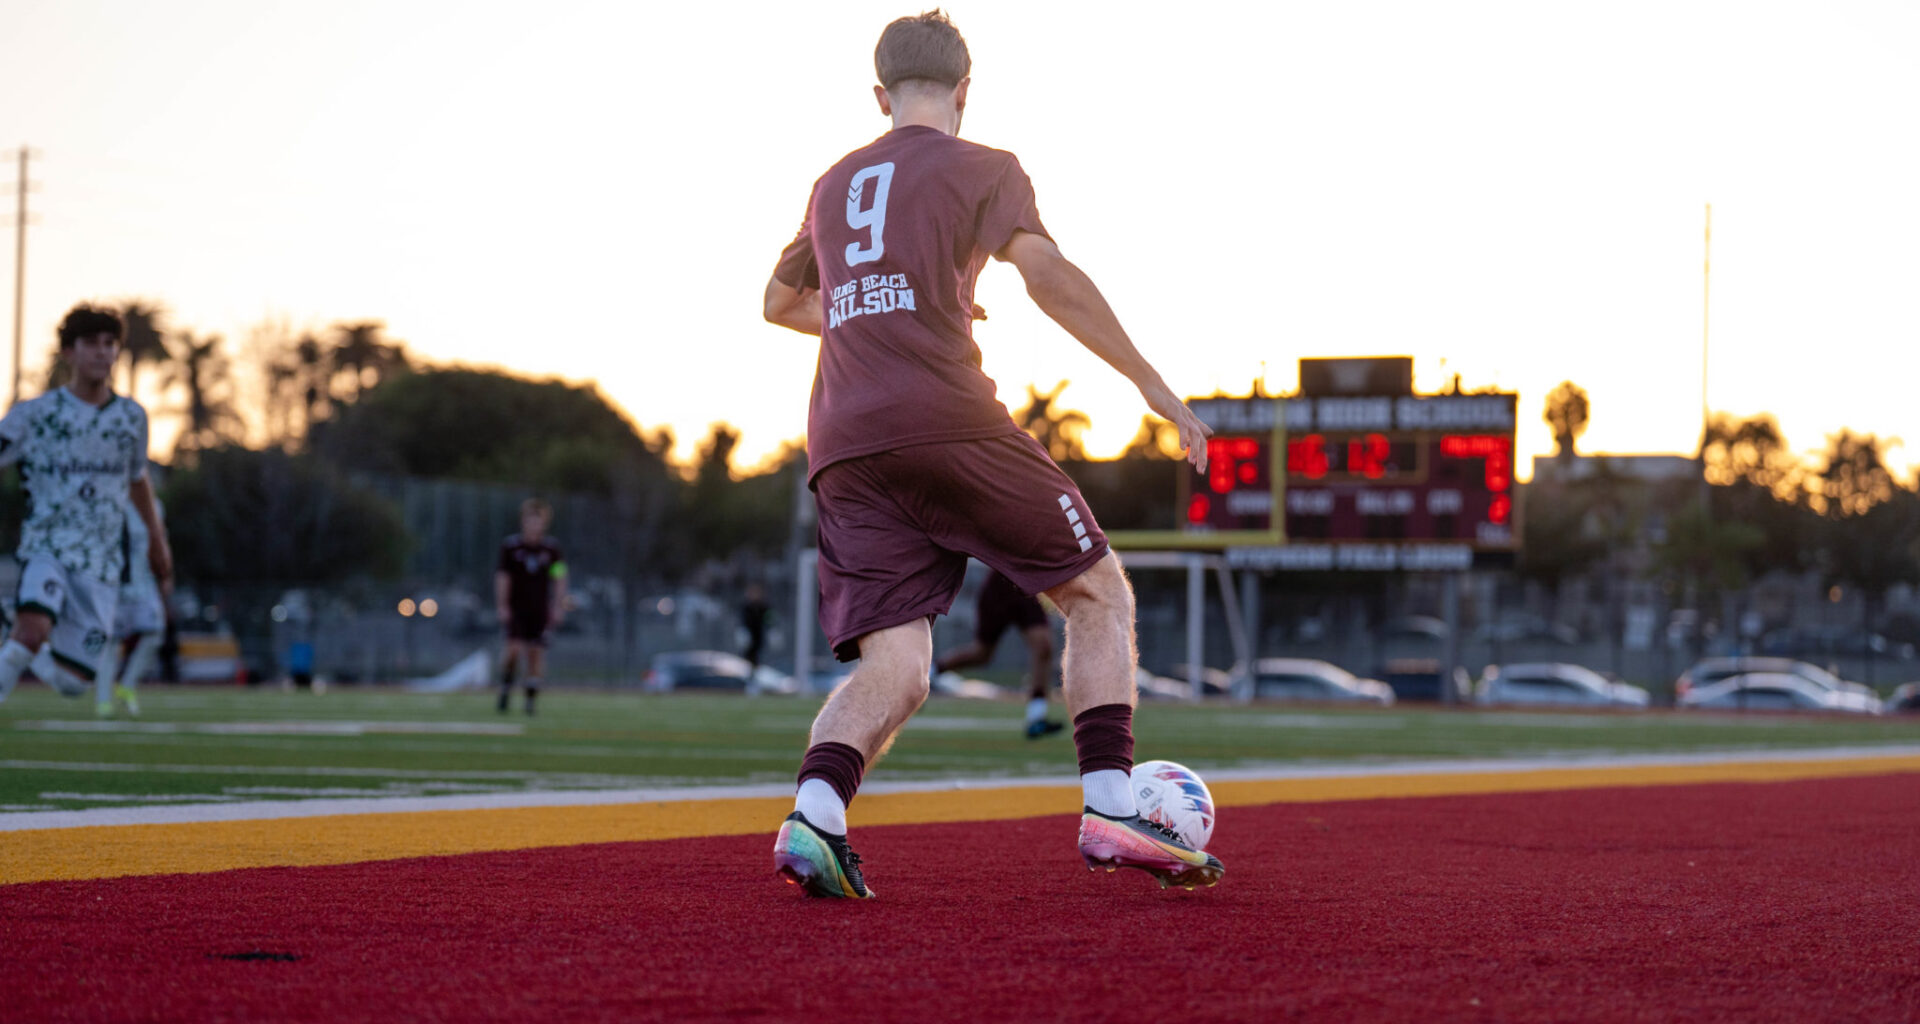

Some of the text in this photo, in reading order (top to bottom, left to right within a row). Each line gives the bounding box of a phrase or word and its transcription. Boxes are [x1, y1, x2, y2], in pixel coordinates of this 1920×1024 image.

[845, 162, 896, 267] 9
[861, 273, 909, 292] BEACH
[829, 287, 917, 329] WILSON
